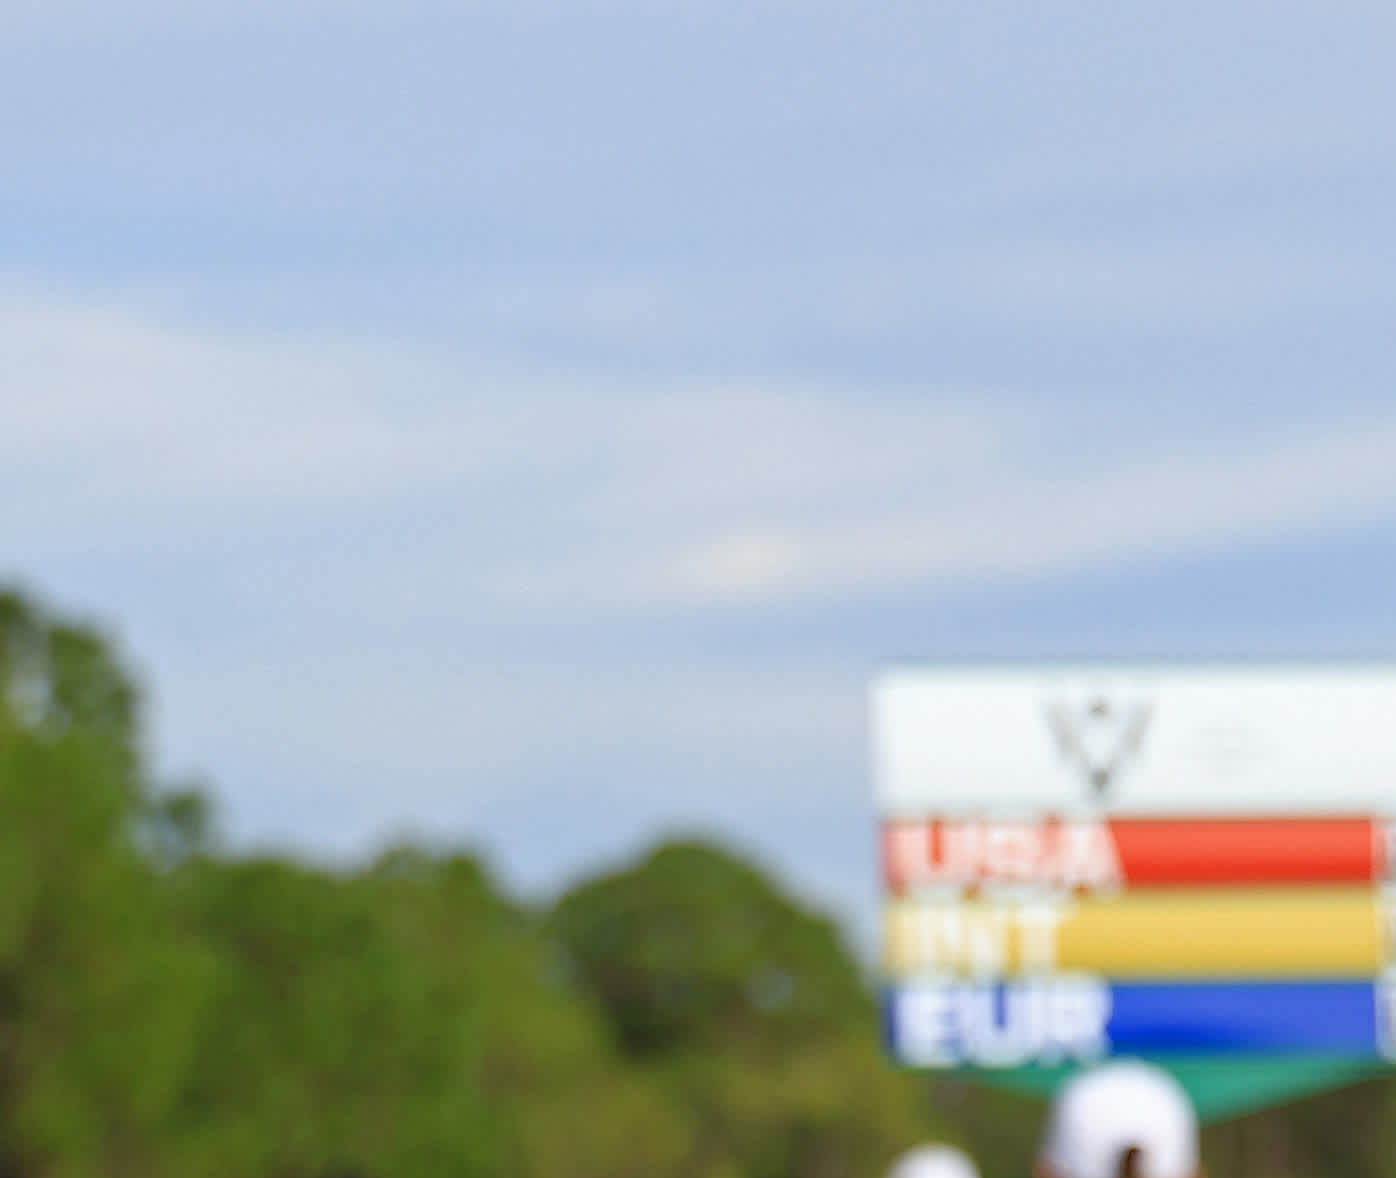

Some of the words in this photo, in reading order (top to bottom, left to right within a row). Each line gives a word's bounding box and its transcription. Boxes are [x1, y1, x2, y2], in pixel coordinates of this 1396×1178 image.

[889, 812, 1120, 891] USA
[889, 891, 1075, 977] INT
[894, 977, 1111, 1063] EUR
